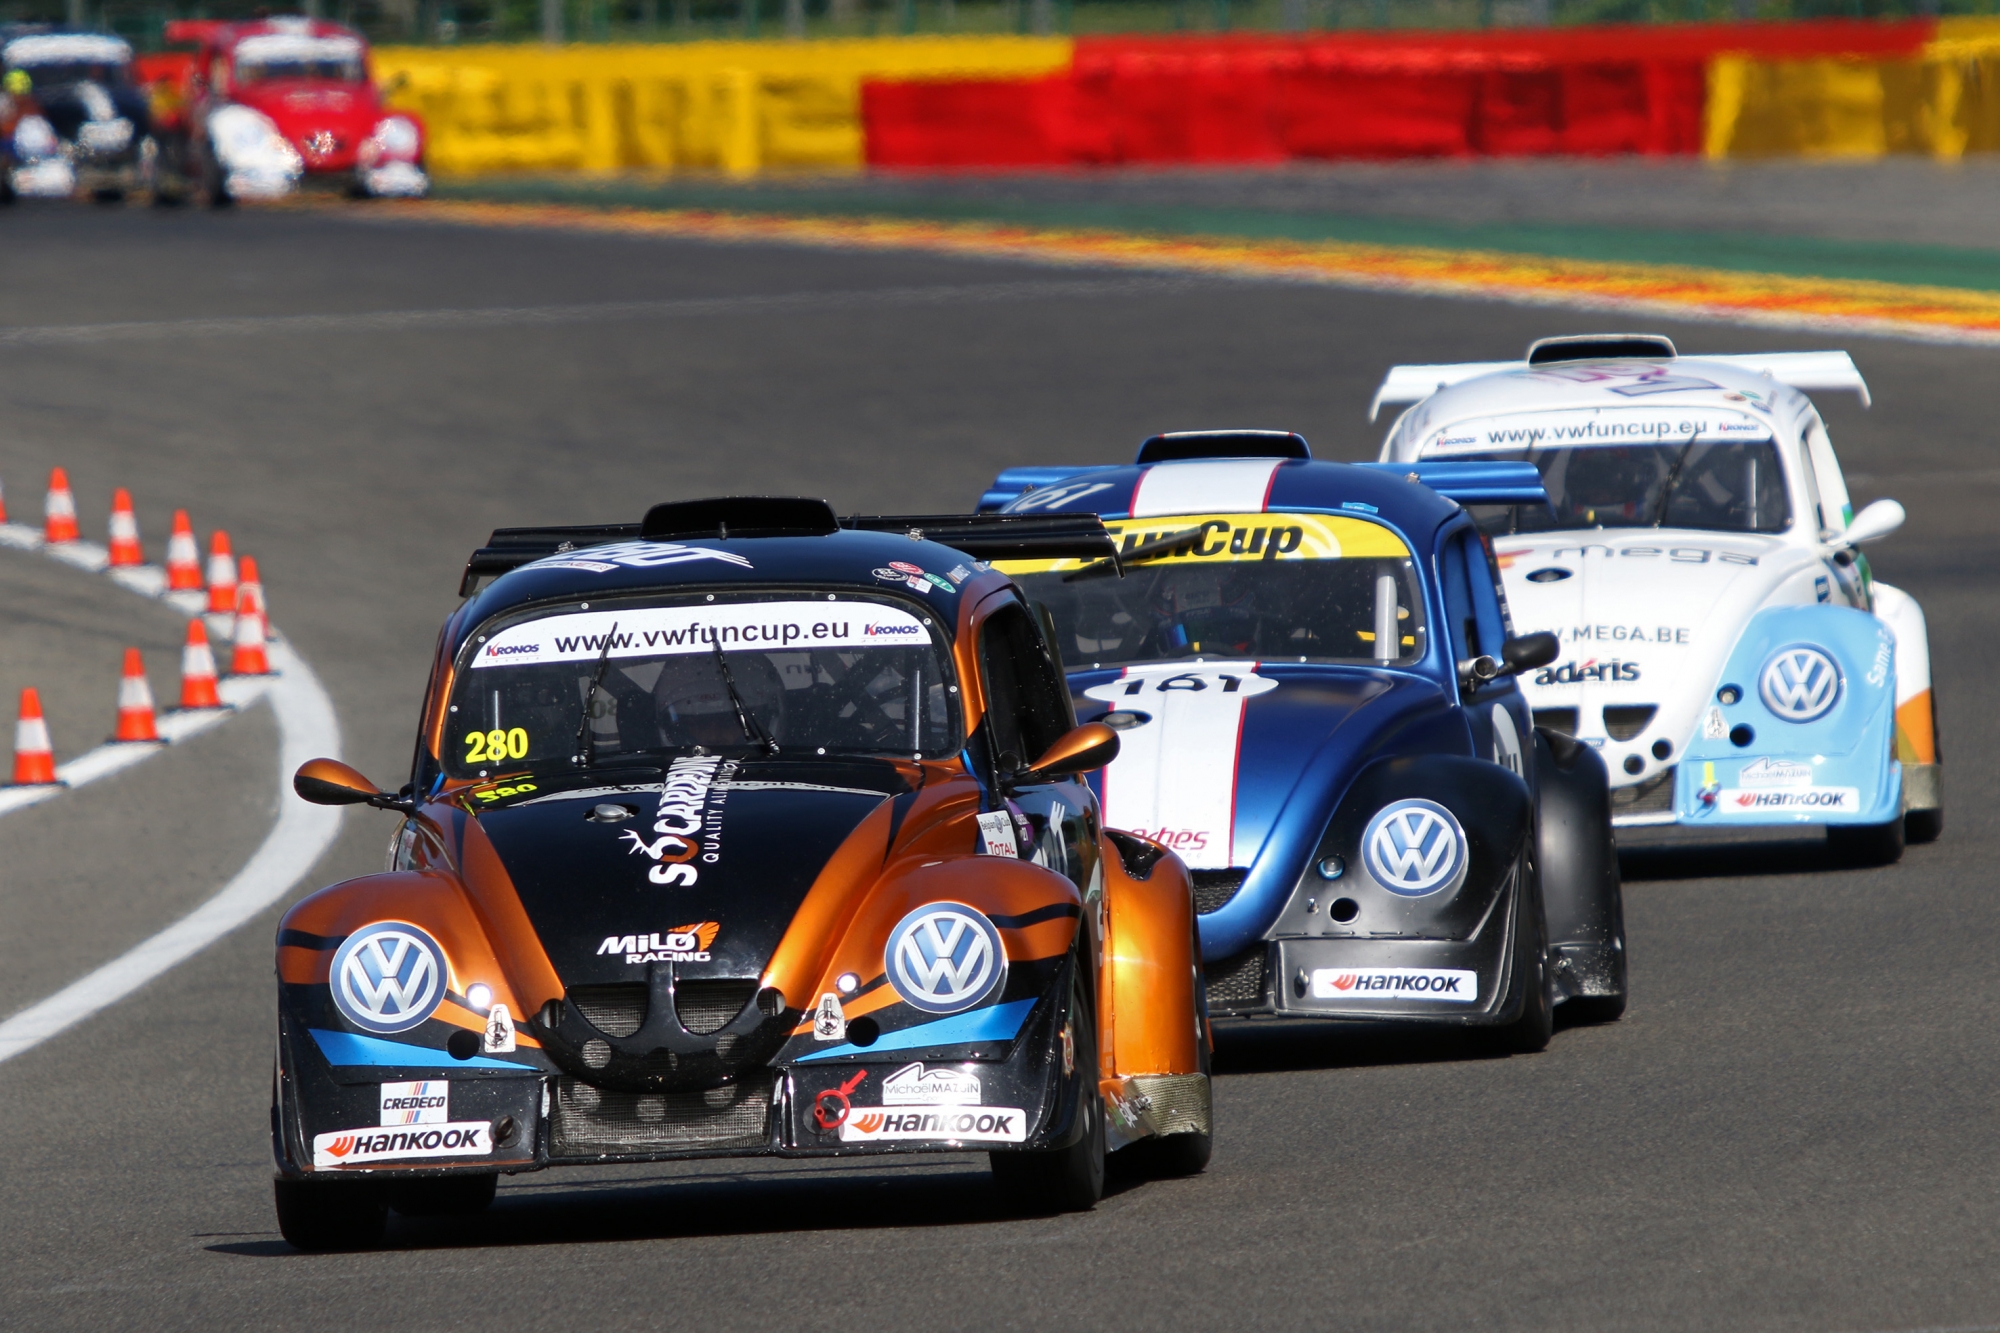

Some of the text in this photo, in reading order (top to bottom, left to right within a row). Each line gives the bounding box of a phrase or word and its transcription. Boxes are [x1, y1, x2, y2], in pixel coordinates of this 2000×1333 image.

[1487, 419, 1707, 444] www.vwfuncup.eu
[554, 612, 850, 653] www.vwfuncup.eu
[863, 620, 920, 636] KRONOS
[485, 641, 540, 657] KRONOS
[1120, 673, 1243, 696] 161
[464, 727, 529, 764] 280
[702, 809, 724, 863] QUALITY
[625, 951, 711, 964] RACING
[382, 1095, 446, 1111] CREDECO
